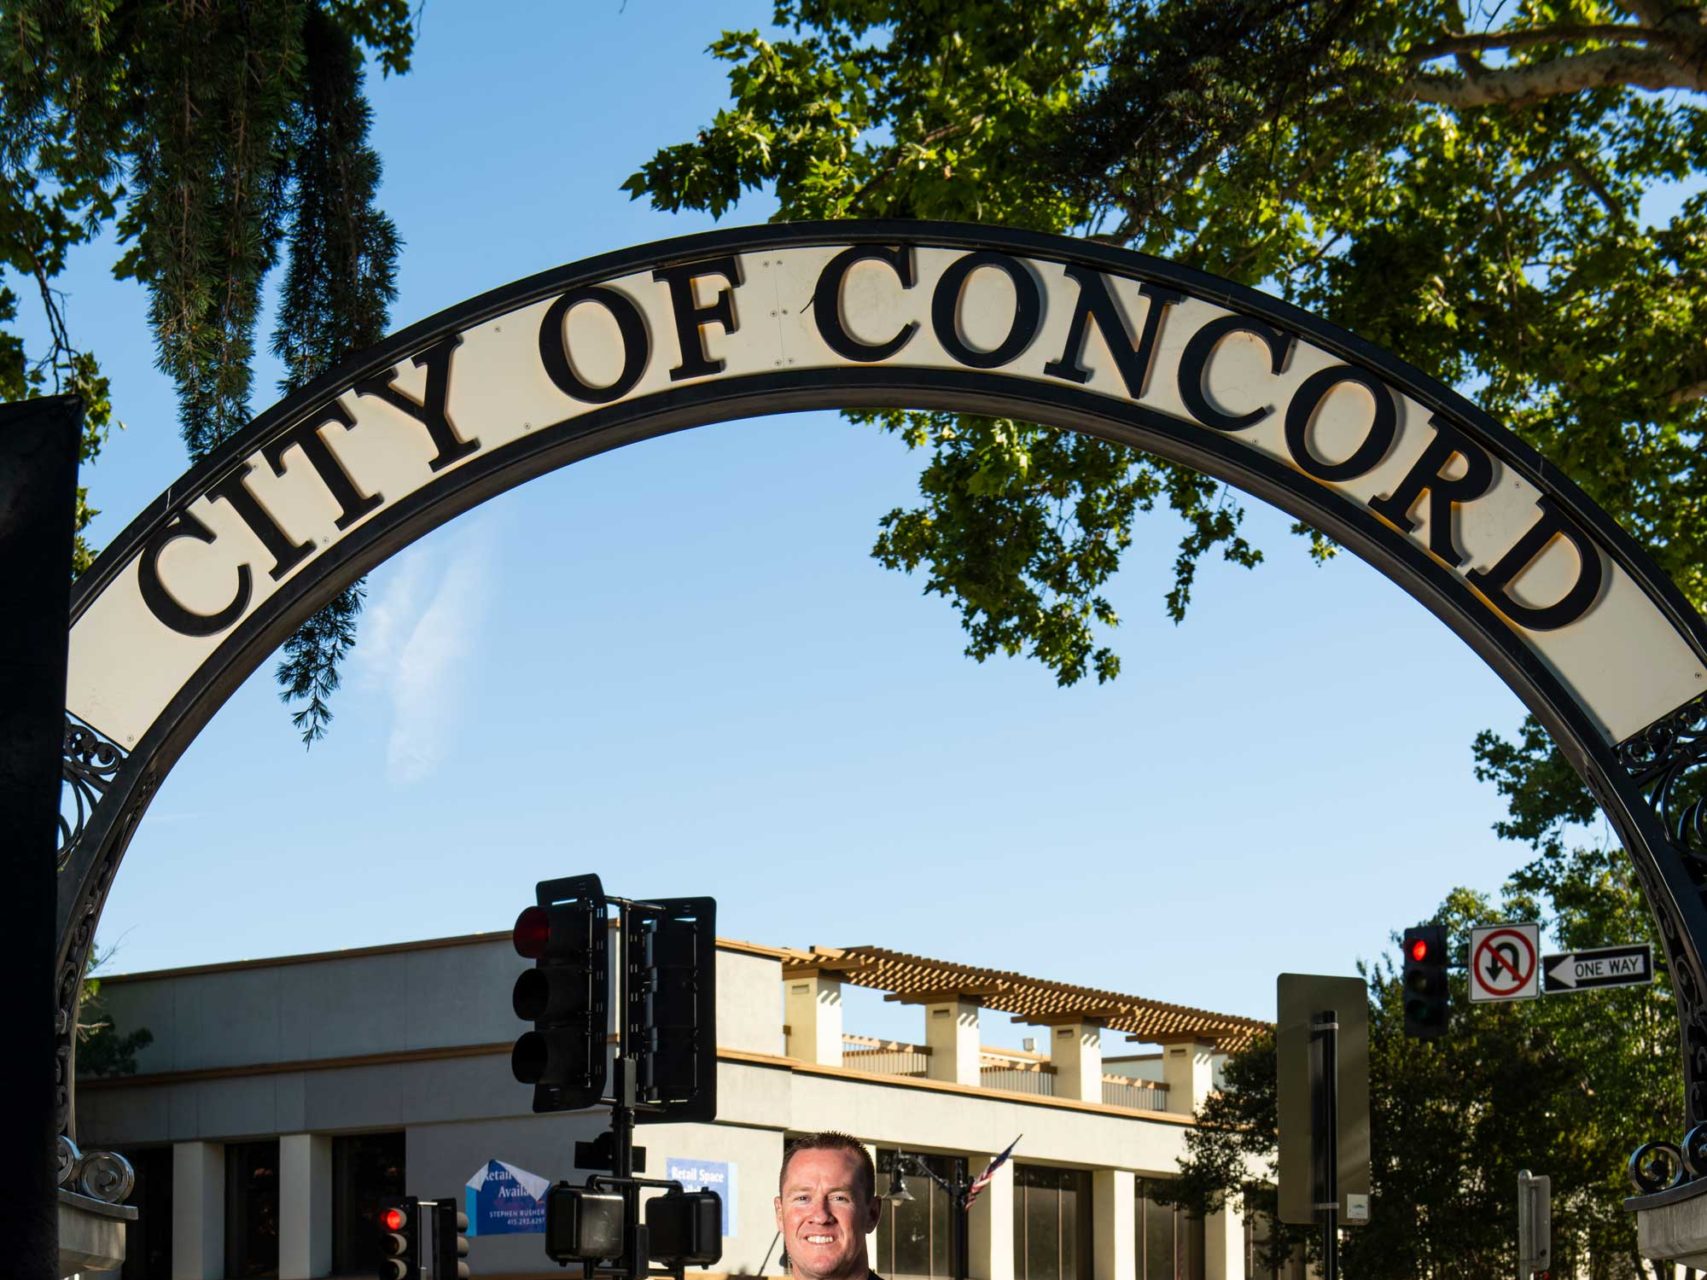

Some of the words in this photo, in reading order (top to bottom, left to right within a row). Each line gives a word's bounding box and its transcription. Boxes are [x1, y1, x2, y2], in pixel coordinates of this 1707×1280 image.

[137, 335, 481, 638] CITY
[538, 255, 744, 404] OF
[813, 245, 1603, 632] CONCORD
[1574, 961, 1604, 978] ONE
[1608, 957, 1639, 974] WAY
[671, 1166, 697, 1181] Retail
[699, 1168, 724, 1185] Space
